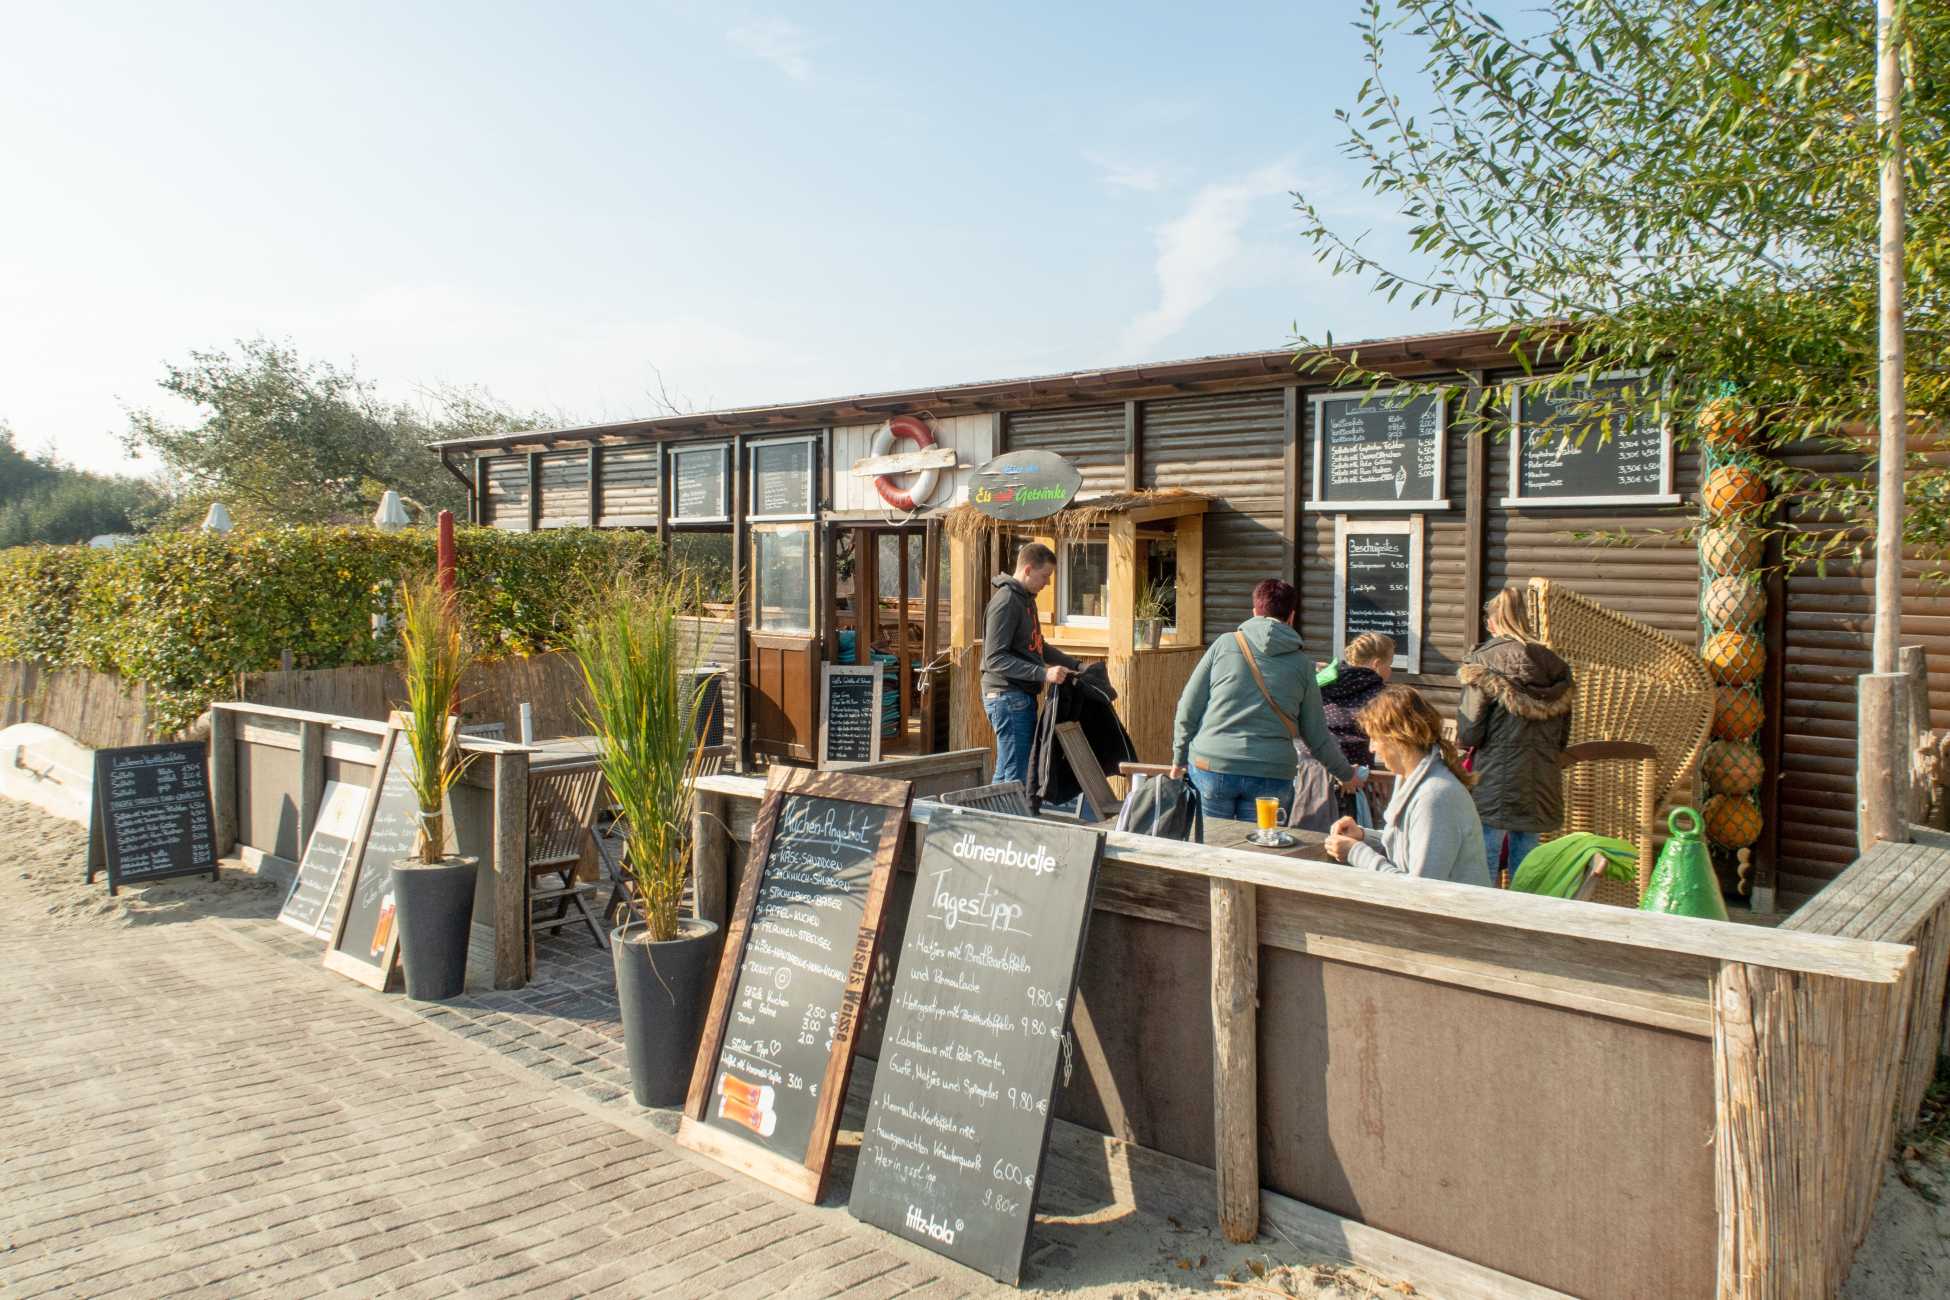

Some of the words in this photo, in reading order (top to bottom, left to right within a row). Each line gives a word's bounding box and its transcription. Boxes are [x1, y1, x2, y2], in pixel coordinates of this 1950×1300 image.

[975, 485, 992, 503] Eis
[1016, 482, 1067, 507] Getränke
[953, 833, 1057, 876] dünenbudje
[928, 867, 1024, 932] Tagestipp
[910, 965, 930, 982] und
[836, 989, 862, 1042] Weisse
